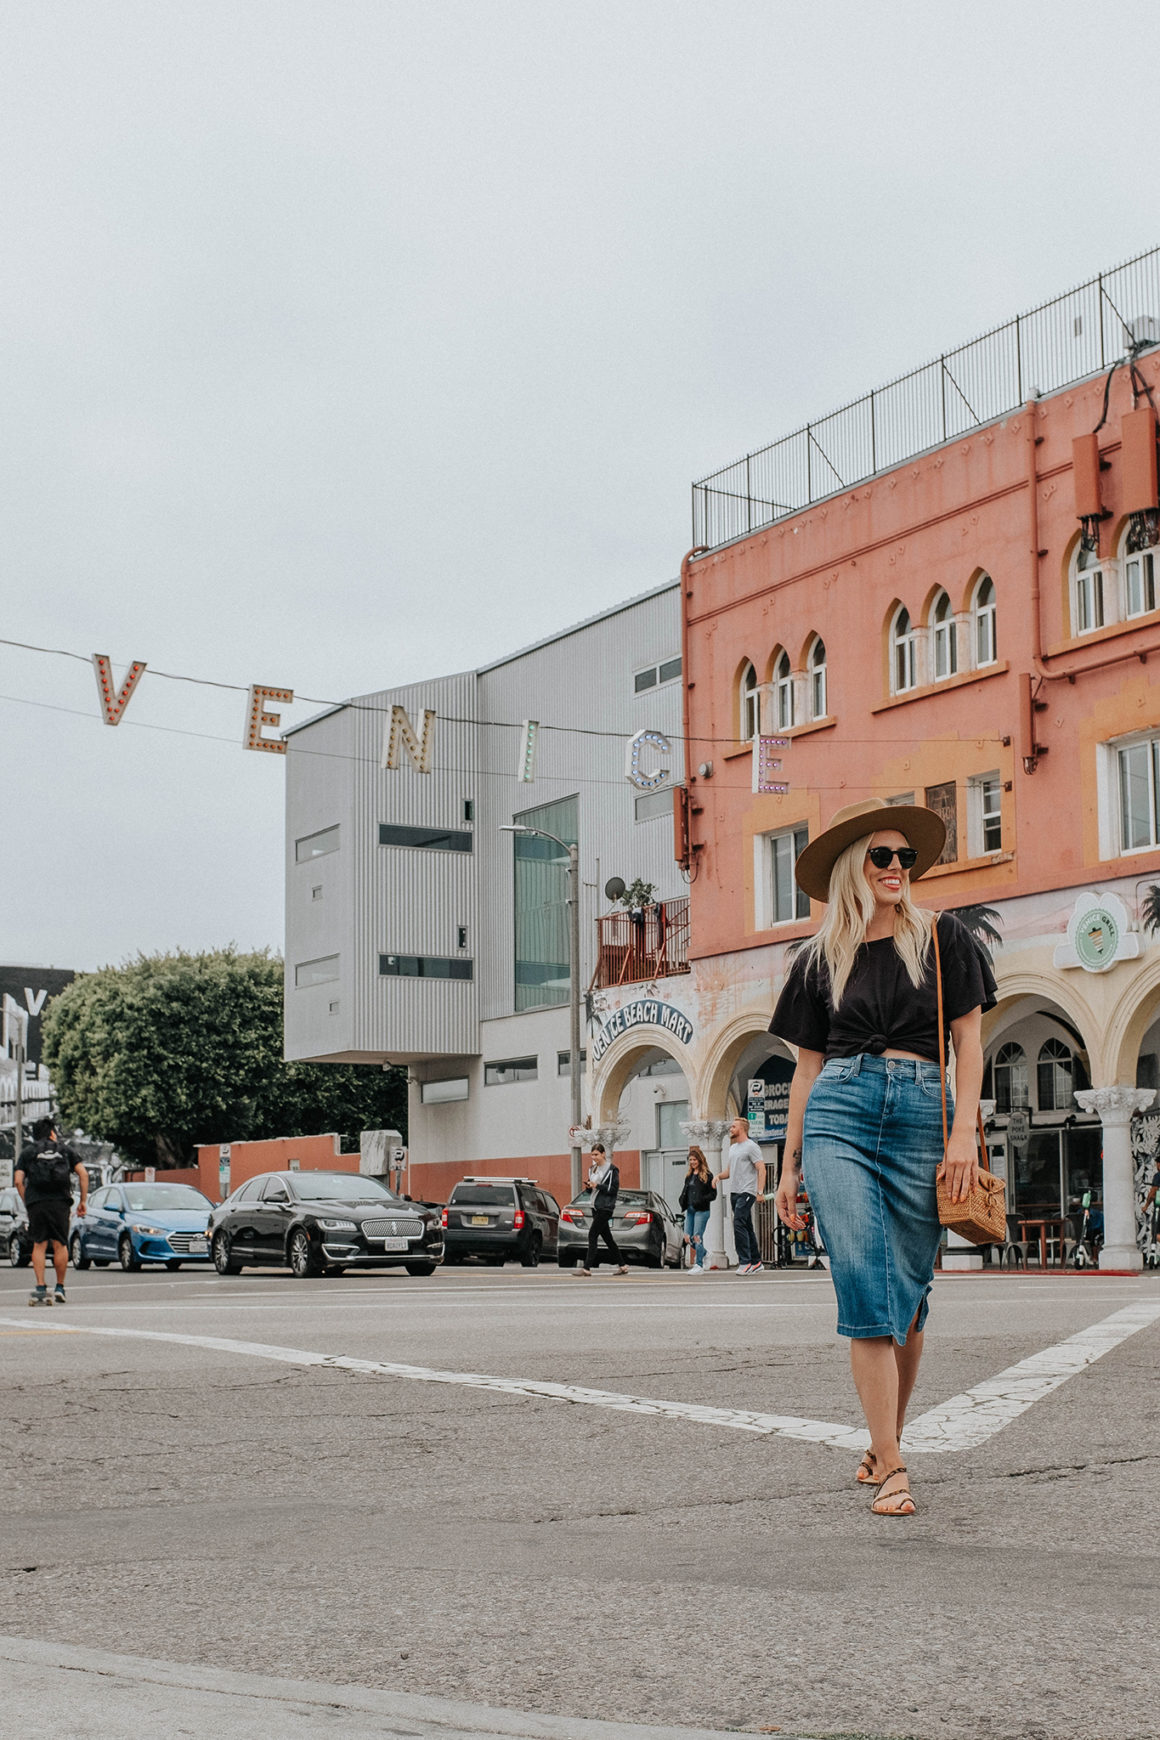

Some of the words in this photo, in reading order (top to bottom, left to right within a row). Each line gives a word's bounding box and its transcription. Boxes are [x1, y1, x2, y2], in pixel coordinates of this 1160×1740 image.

[92, 653, 791, 795] VENICE
[1080, 914, 1100, 933] VENICE
[623, 1002, 659, 1026] BEACH
[661, 1005, 693, 1043] MART
